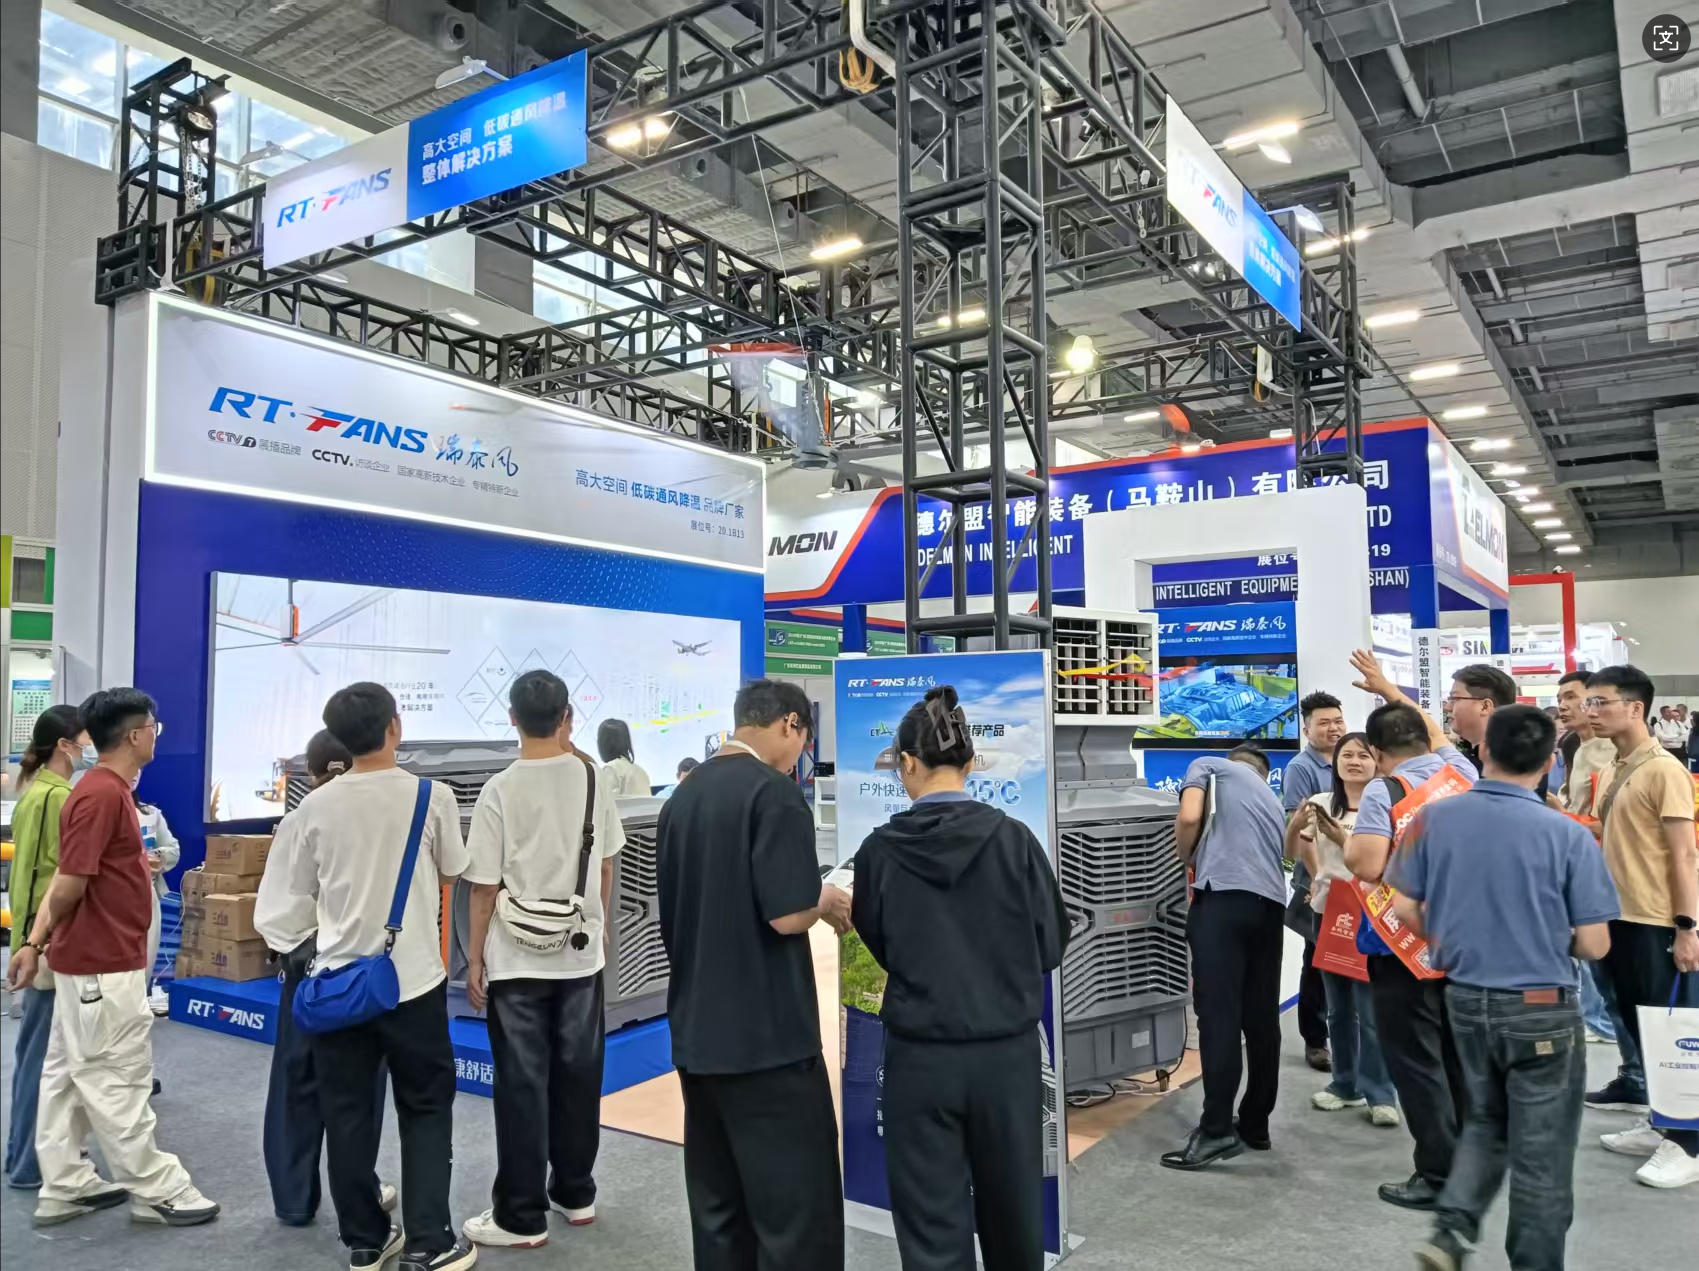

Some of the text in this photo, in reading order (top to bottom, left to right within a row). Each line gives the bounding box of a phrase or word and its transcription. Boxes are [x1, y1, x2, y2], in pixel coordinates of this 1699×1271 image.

[422, 91, 566, 160] 高大空间 低碳通风降温
[422, 134, 513, 185] 整体解决方案
[397, 464, 467, 487] 国家高新技术企业
[575, 469, 744, 519] 高大空间 低碳通风降温 品牌厂家
[1155, 581, 1233, 601] INTELLIGENT
[1418, 636, 1431, 709] 德尔盟智能装备
